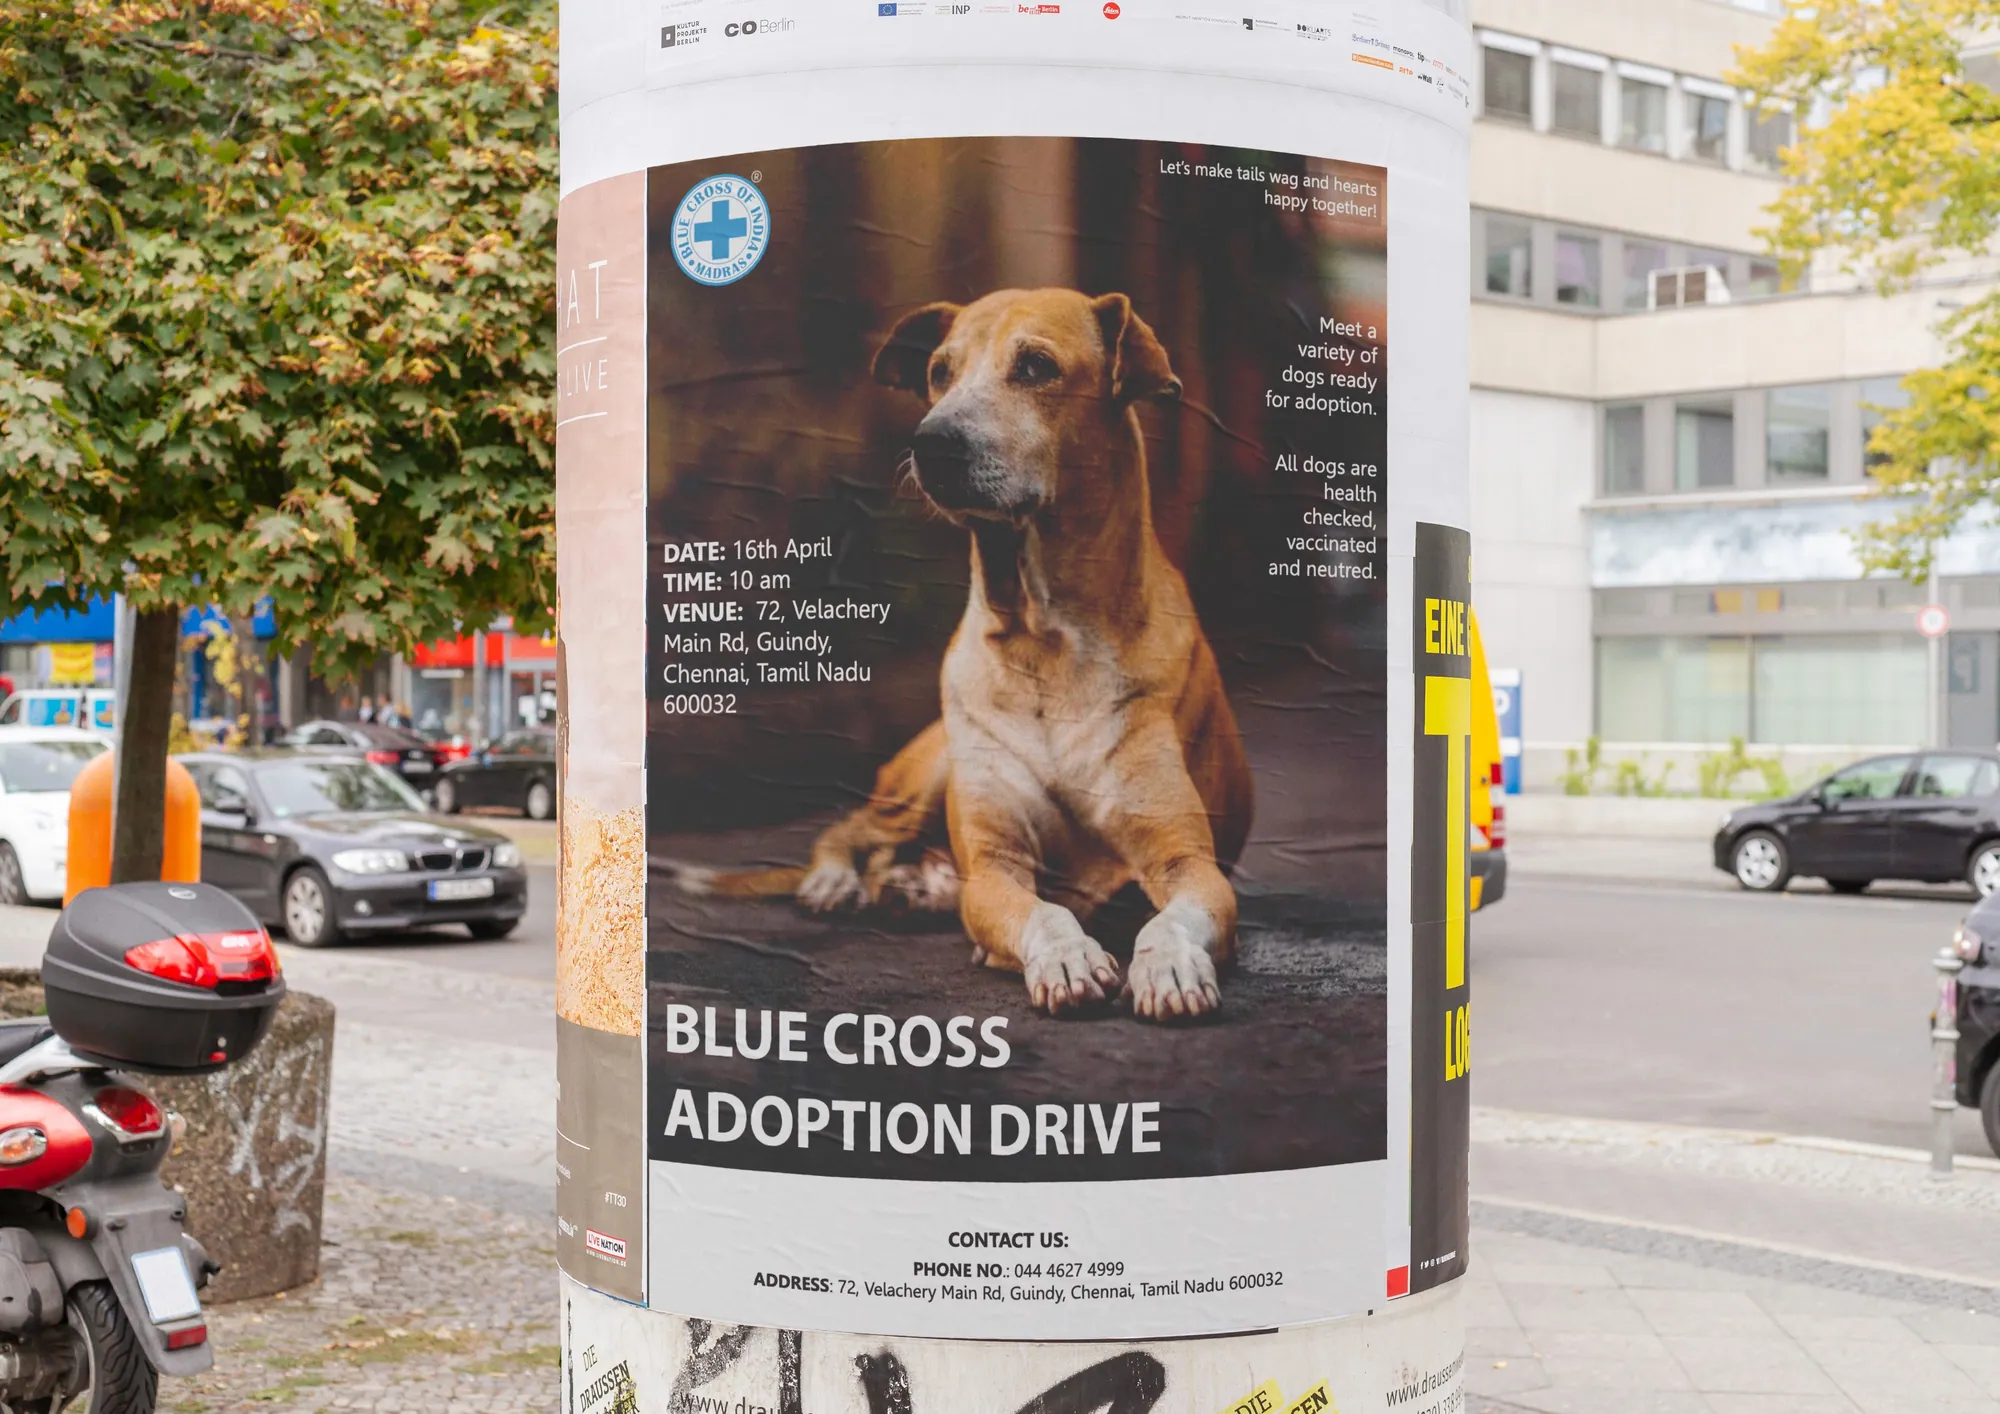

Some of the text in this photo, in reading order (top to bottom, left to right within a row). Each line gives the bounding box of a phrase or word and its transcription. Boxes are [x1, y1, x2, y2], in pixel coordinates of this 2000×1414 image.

[677, 20, 700, 30] KULTUR
[677, 27, 707, 38] PROJEKTE
[760, 17, 796, 34] Berlin
[677, 37, 700, 46] BERLIN
[1195, 163, 1233, 179] make
[1236, 166, 1265, 182] tails
[1269, 172, 1298, 189] wag
[1303, 173, 1328, 190] and
[1333, 177, 1377, 197] hearts
[1264, 190, 1377, 218] happy together!
[677, 181, 764, 259] BLUE CROSS OF INDIA
[694, 257, 748, 279] MADRAS
[1319, 316, 1377, 339] Meet a
[1298, 342, 1378, 366] variety of
[1282, 365, 1378, 394] dogs ready
[1265, 389, 1377, 416] for adoption.
[1275, 454, 1378, 479] All dogs are
[1324, 482, 1377, 503] health
[1303, 507, 1377, 531] checked,
[663, 536, 833, 564] DATE: 16th April
[1286, 534, 1377, 554] vaccinated
[663, 570, 791, 593] TIME: 10 am
[1268, 559, 1377, 580] and neutred.
[663, 598, 891, 624] VENUE: 72, Velachery
[1425, 598, 1464, 656] EINE
[664, 630, 832, 656] Main Rd, Guindy,
[663, 660, 871, 685] Chennai, Tamil Nadu
[663, 694, 737, 714] 600032
[666, 1003, 1011, 1069] BLUE CROSS
[663, 1088, 1161, 1156] ADOPTION DRIVE
[605, 1192, 626, 1207] #TT30
[588, 1233, 624, 1253] LIVE NATION
[948, 1232, 1069, 1248] CONTACT US:
[913, 1261, 1125, 1278] PHONE NO.: 044 4627 4999
[753, 1271, 1283, 1304] ADDRESS: 72, Velachery Main Rd, Guindy, Chennai, Tamil Nadu 600032
[582, 1344, 598, 1372] DIE
[580, 1359, 630, 1413] DRAUSSEN
